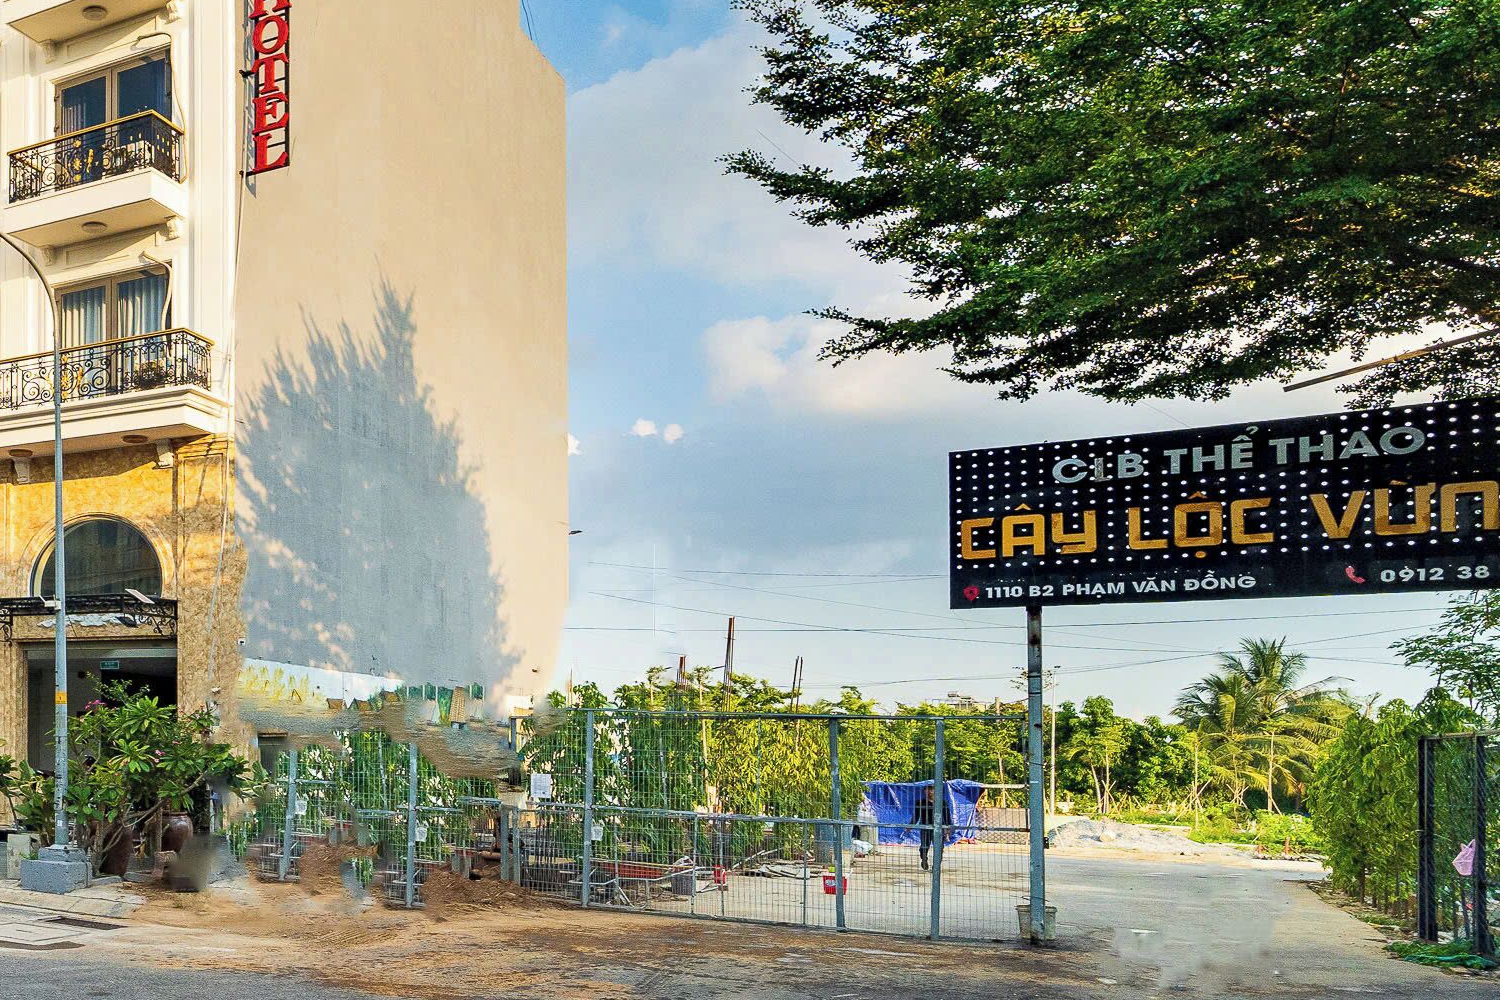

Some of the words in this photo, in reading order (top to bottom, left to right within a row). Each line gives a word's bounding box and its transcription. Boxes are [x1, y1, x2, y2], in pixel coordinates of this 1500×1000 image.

[1163, 426, 1260, 475] THỂ
[960, 503, 1098, 560] CÂY
[1128, 491, 1275, 558] LỘC
[985, 585, 1023, 599] 1110
[1028, 584, 1055, 597] B2
[1062, 582, 1126, 599] PHẠM
[1132, 576, 1177, 593] VĂN
[1380, 567, 1445, 583] 0912
[1457, 565, 1491, 580] 38
